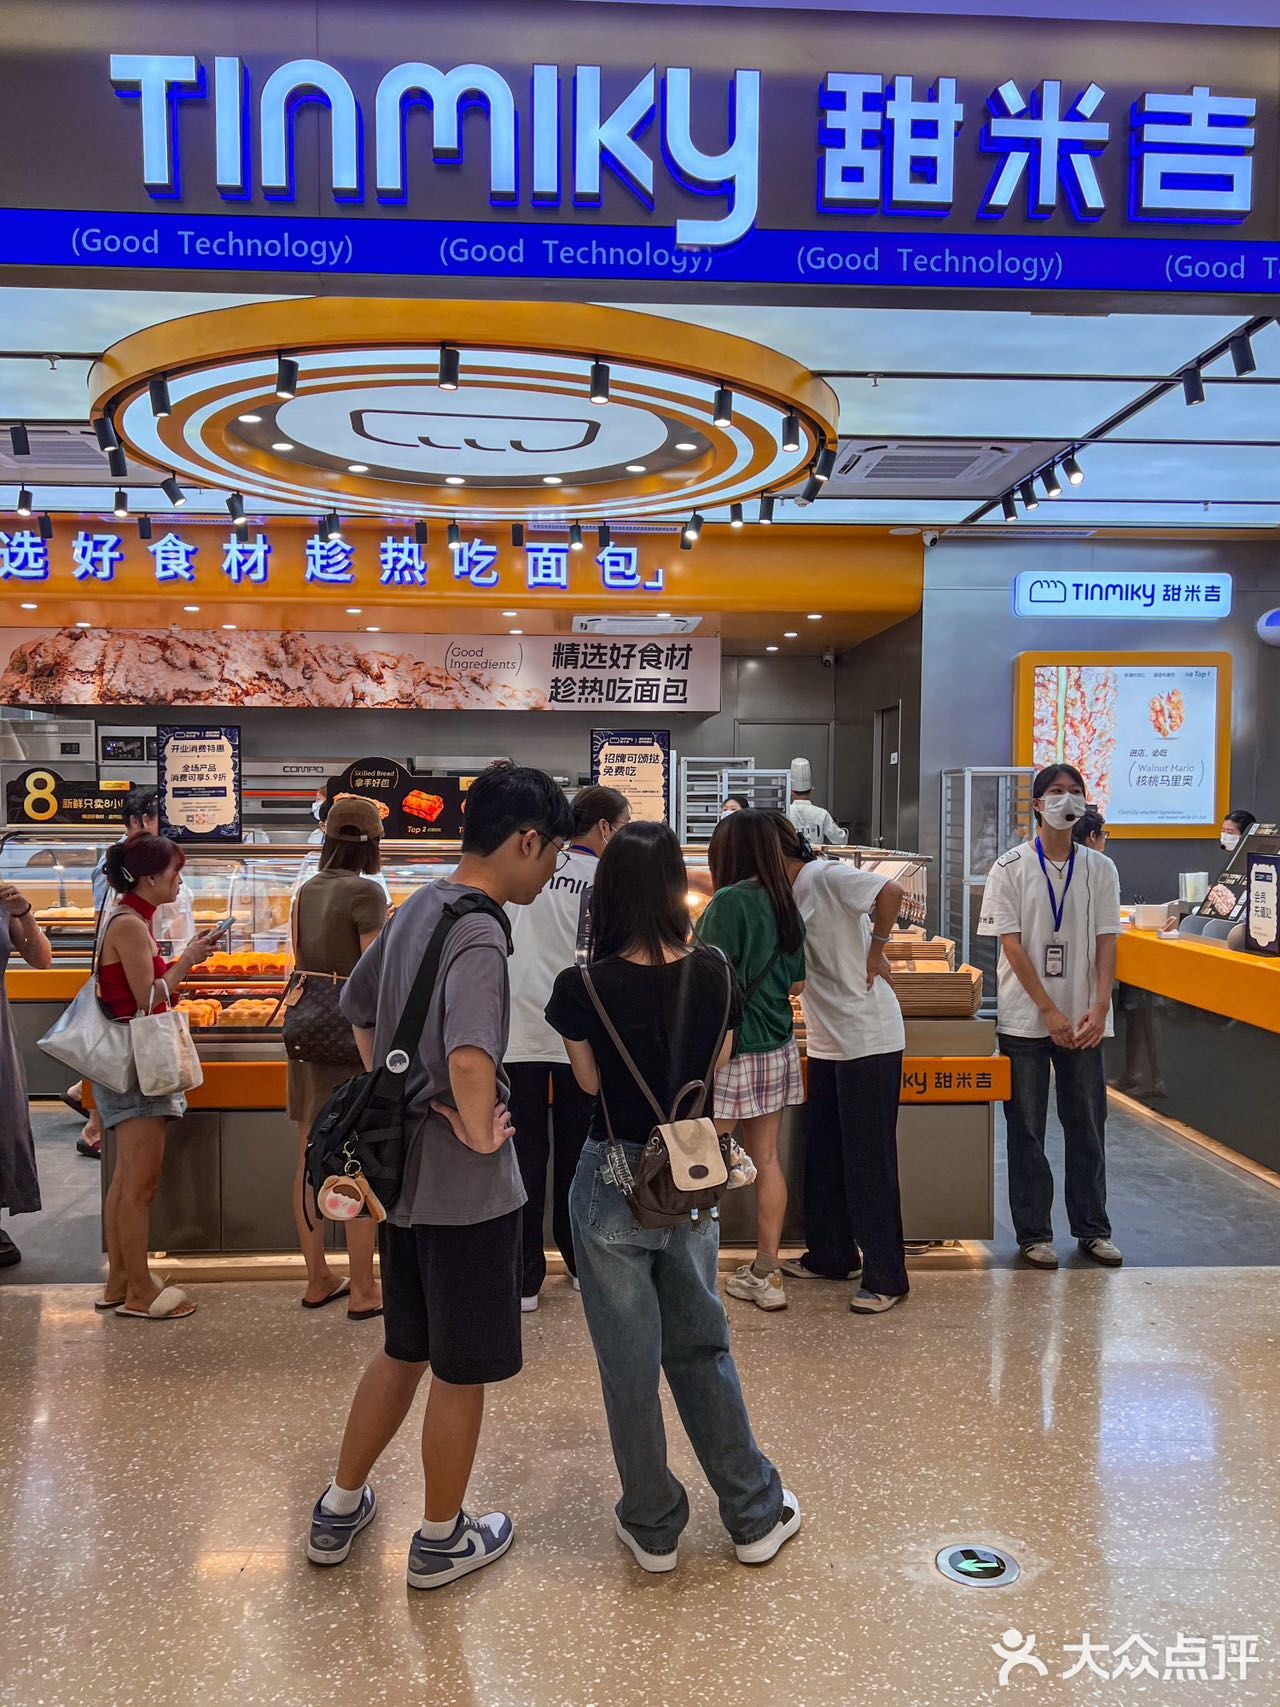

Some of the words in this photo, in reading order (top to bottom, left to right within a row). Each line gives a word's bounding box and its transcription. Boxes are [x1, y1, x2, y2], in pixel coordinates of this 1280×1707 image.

[820, 72, 1257, 220] 甜米吉
[71, 228, 159, 257] (Good
[177, 230, 353, 266] Technology)
[440, 237, 525, 267] (Good
[797, 246, 879, 275] (Good
[897, 248, 1063, 282] Technology)
[1165, 254, 1245, 280] (Good
[1162, 584, 1221, 602] 甜米吉
[551, 642, 693, 670] 精选好食材
[548, 676, 688, 704] 趁热吃面包
[171, 744, 225, 753] 开业消费特惠
[604, 753, 660, 764] 招牌可颂挞
[182, 763, 217, 772] 全场产品
[602, 765, 637, 777] 免费吃
[1138, 763, 1169, 773] Walnut
[1170, 763, 1195, 773] Mario
[170, 773, 227, 782] 消费可享5.9折
[354, 778, 390, 788] 拿手好包
[1136, 775, 1194, 787] 核桃马里奥
[23, 770, 58, 821] 8
[62, 798, 124, 809] 新鲜只卖8小
[407, 826, 421, 834] Top
[934, 1072, 992, 1089] 甜米吉
